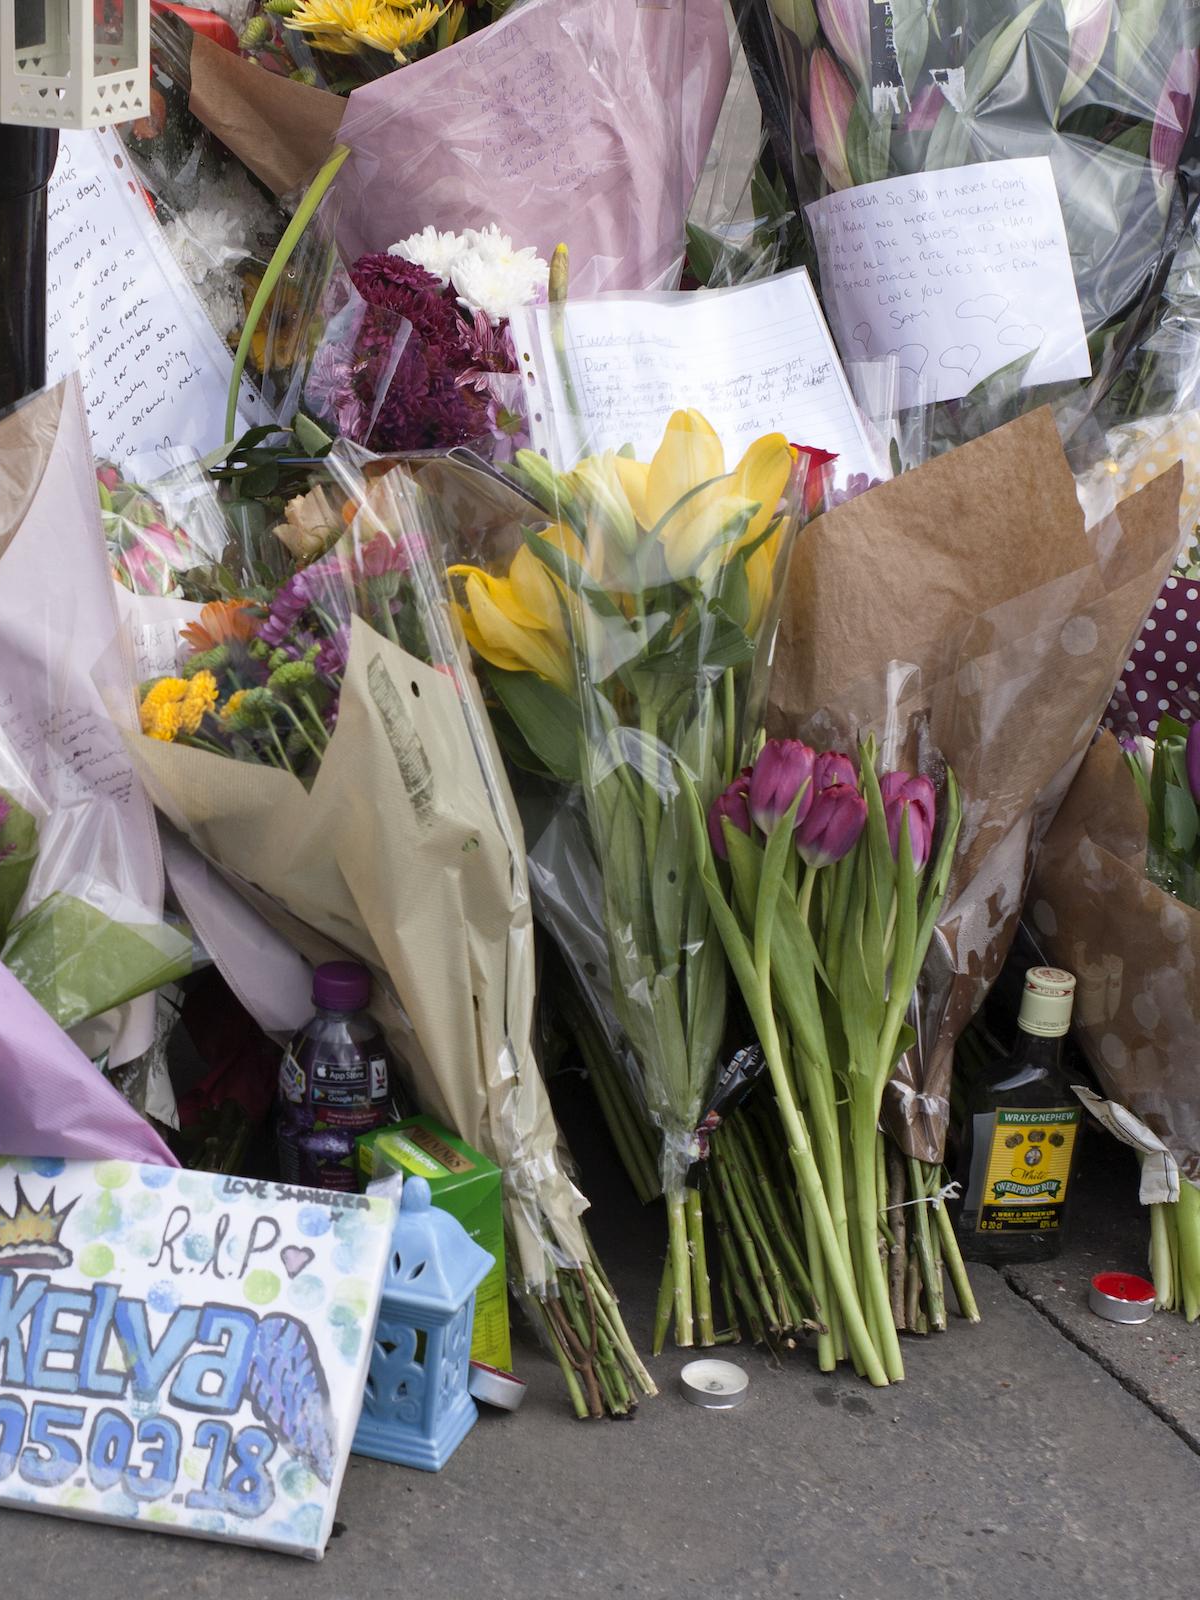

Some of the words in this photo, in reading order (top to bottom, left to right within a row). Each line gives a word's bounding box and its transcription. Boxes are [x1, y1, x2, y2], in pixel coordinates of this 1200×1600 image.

[329, 1070, 345, 1081] App
[328, 1094, 352, 1104] Google
[222, 1177, 268, 1199] LOVE
[995, 1182, 1041, 1195] OVERPROOF
[1041, 1181, 1058, 1192] RUM
